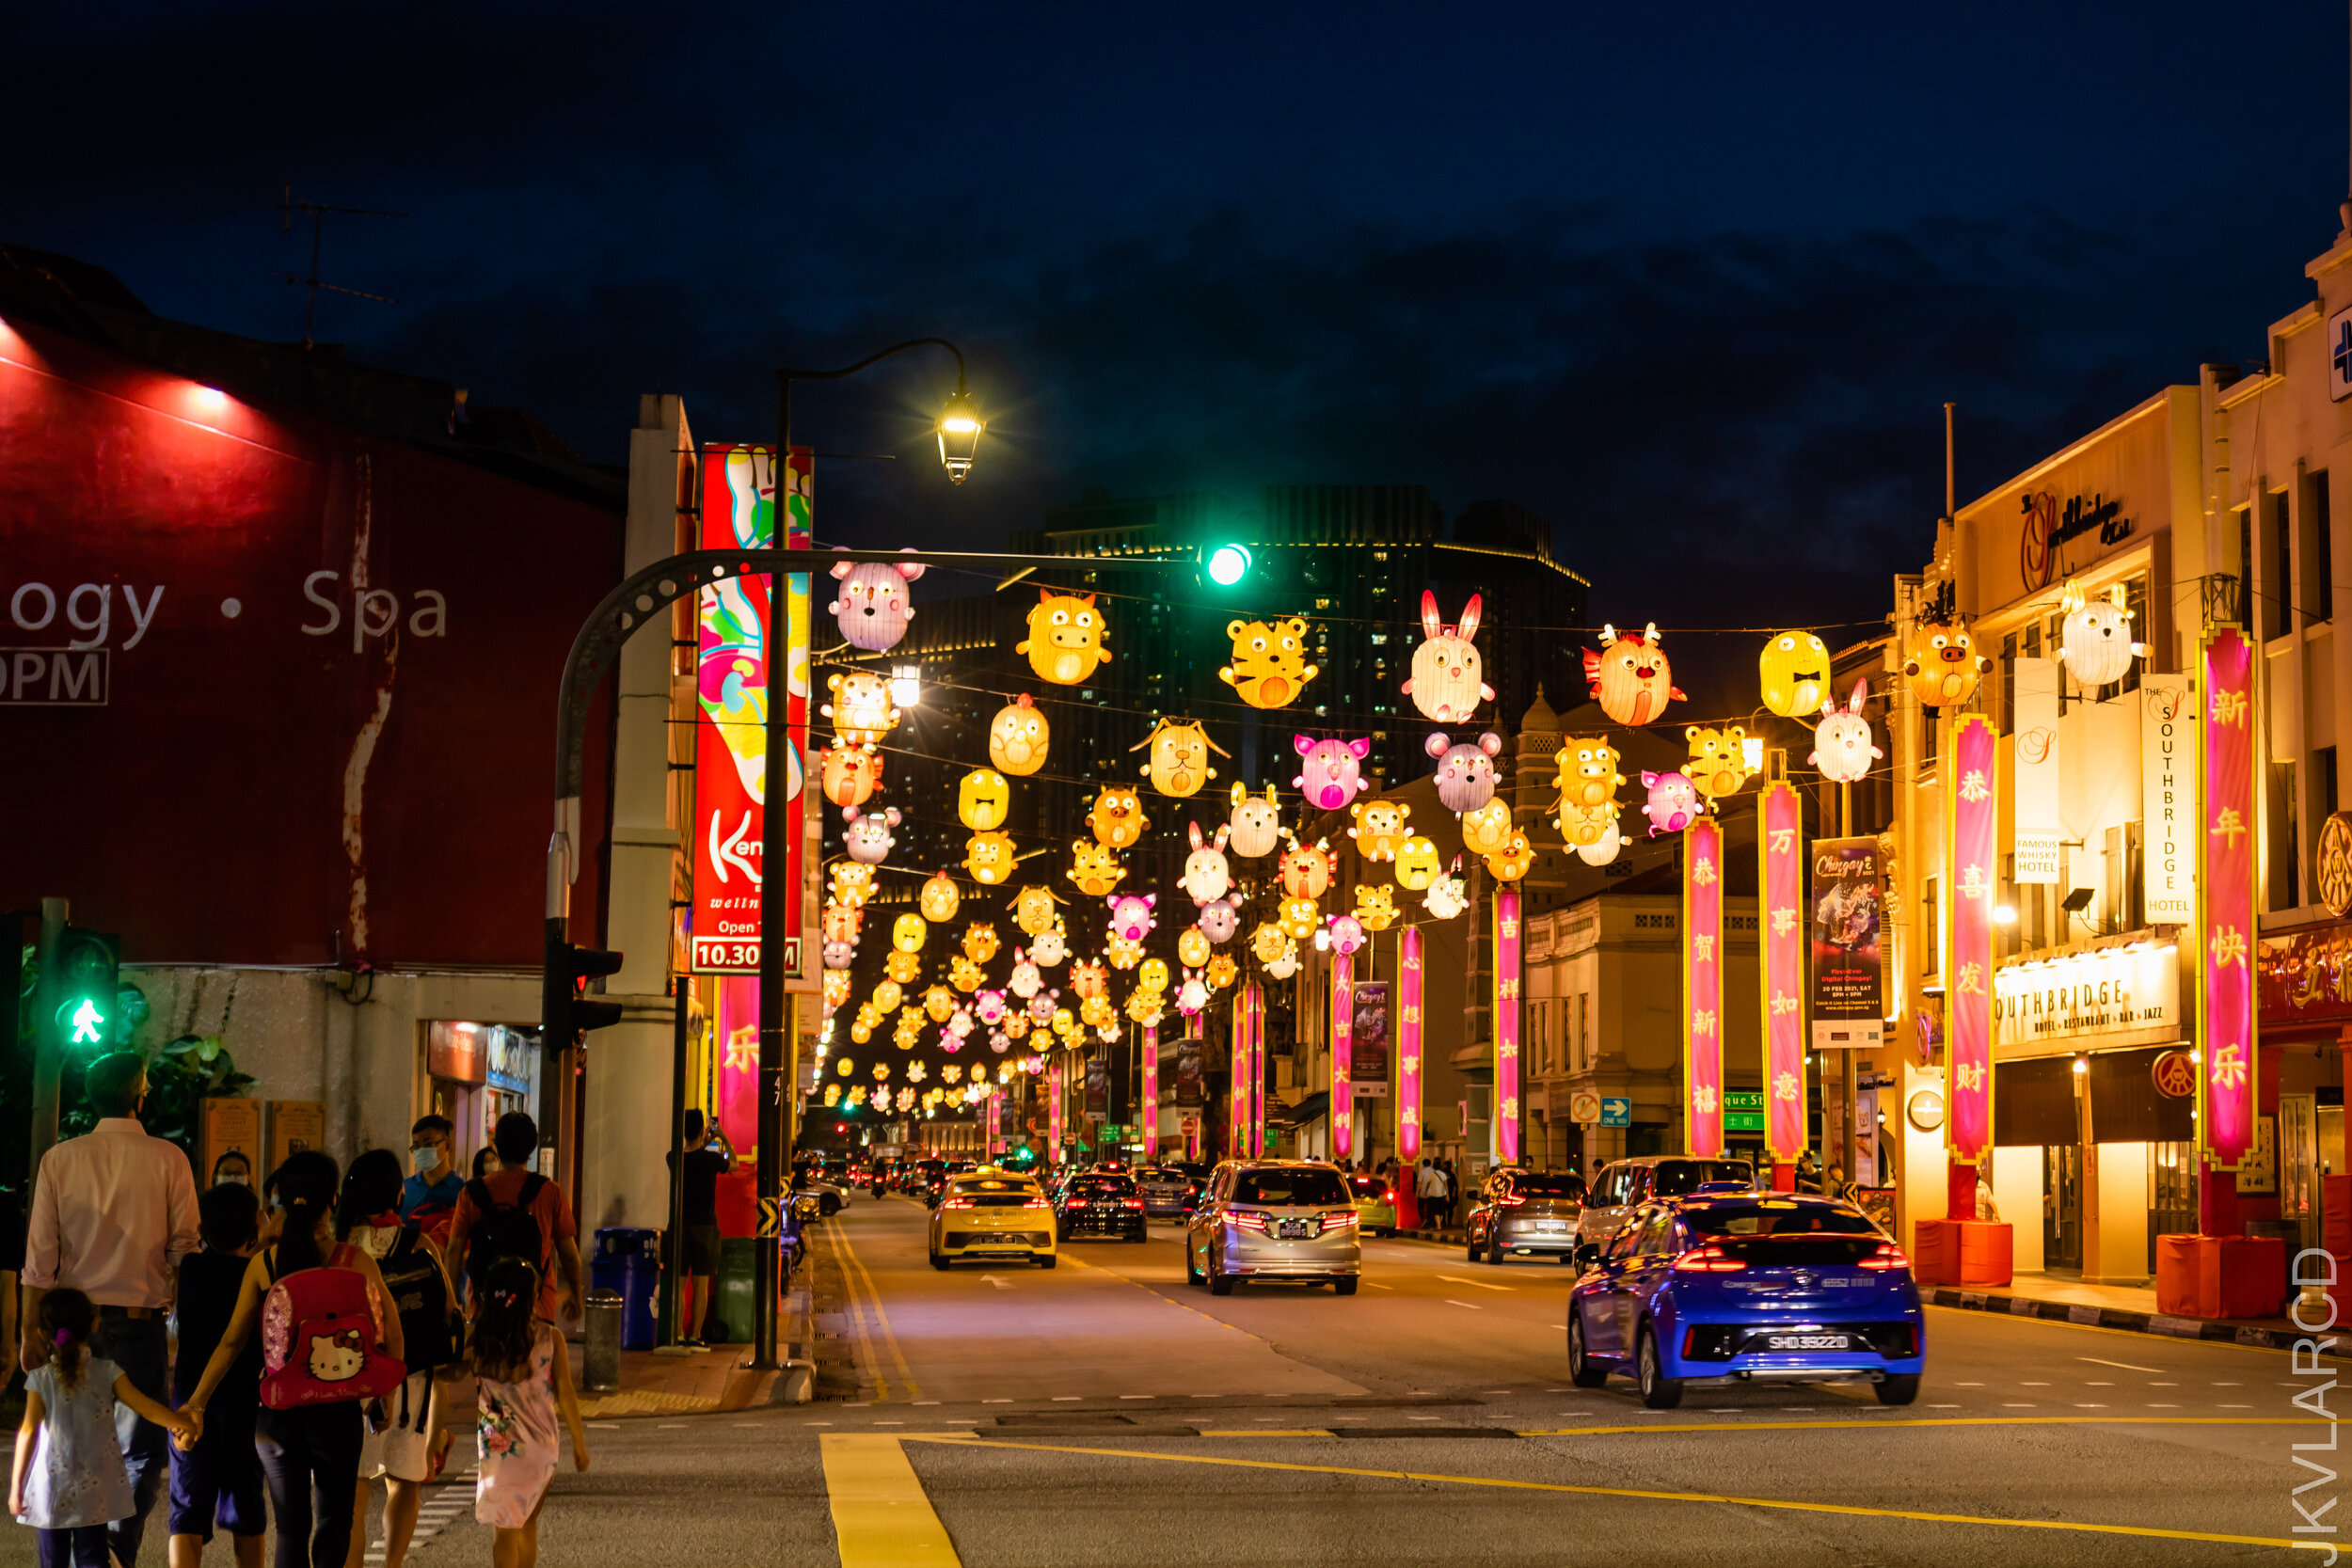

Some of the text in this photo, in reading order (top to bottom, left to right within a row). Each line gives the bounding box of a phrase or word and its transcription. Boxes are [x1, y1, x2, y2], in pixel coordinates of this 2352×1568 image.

[10, 569, 447, 654] ogy Spa
[2145, 688, 2161, 696] THE
[2161, 706, 2176, 890] SOUTHBRIDGE
[2017, 840, 2058, 848] FAMOUS
[2017, 850, 2058, 860] WHISKY
[1816, 855, 1865, 878] Chingay
[2018, 862, 2057, 873] HOTEL
[2211, 689, 2248, 1091] 新年快乐
[710, 896, 758, 910] welln
[2149, 899, 2190, 911] HOTEL
[718, 920, 755, 935] Open
[1955, 769, 1992, 1093] 恭喜发财
[1769, 828, 1799, 1101] 万事如意
[1692, 856, 1718, 1115] 恭贺新禧
[1500, 915, 1519, 1120] 吉祥如意
[2034, 1006, 2163, 1033] HOTEL RESTAURANT BAR JAZZ
[723, 1023, 760, 1074] 乐
[1334, 974, 1351, 1130] 大吉大利
[1401, 956, 1422, 1126] 心想事成
[1751, 1094, 1763, 1105] St
[1603, 1117, 1628, 1125] ONE WAY
[1769, 1336, 1849, 1349] SHD3922D
